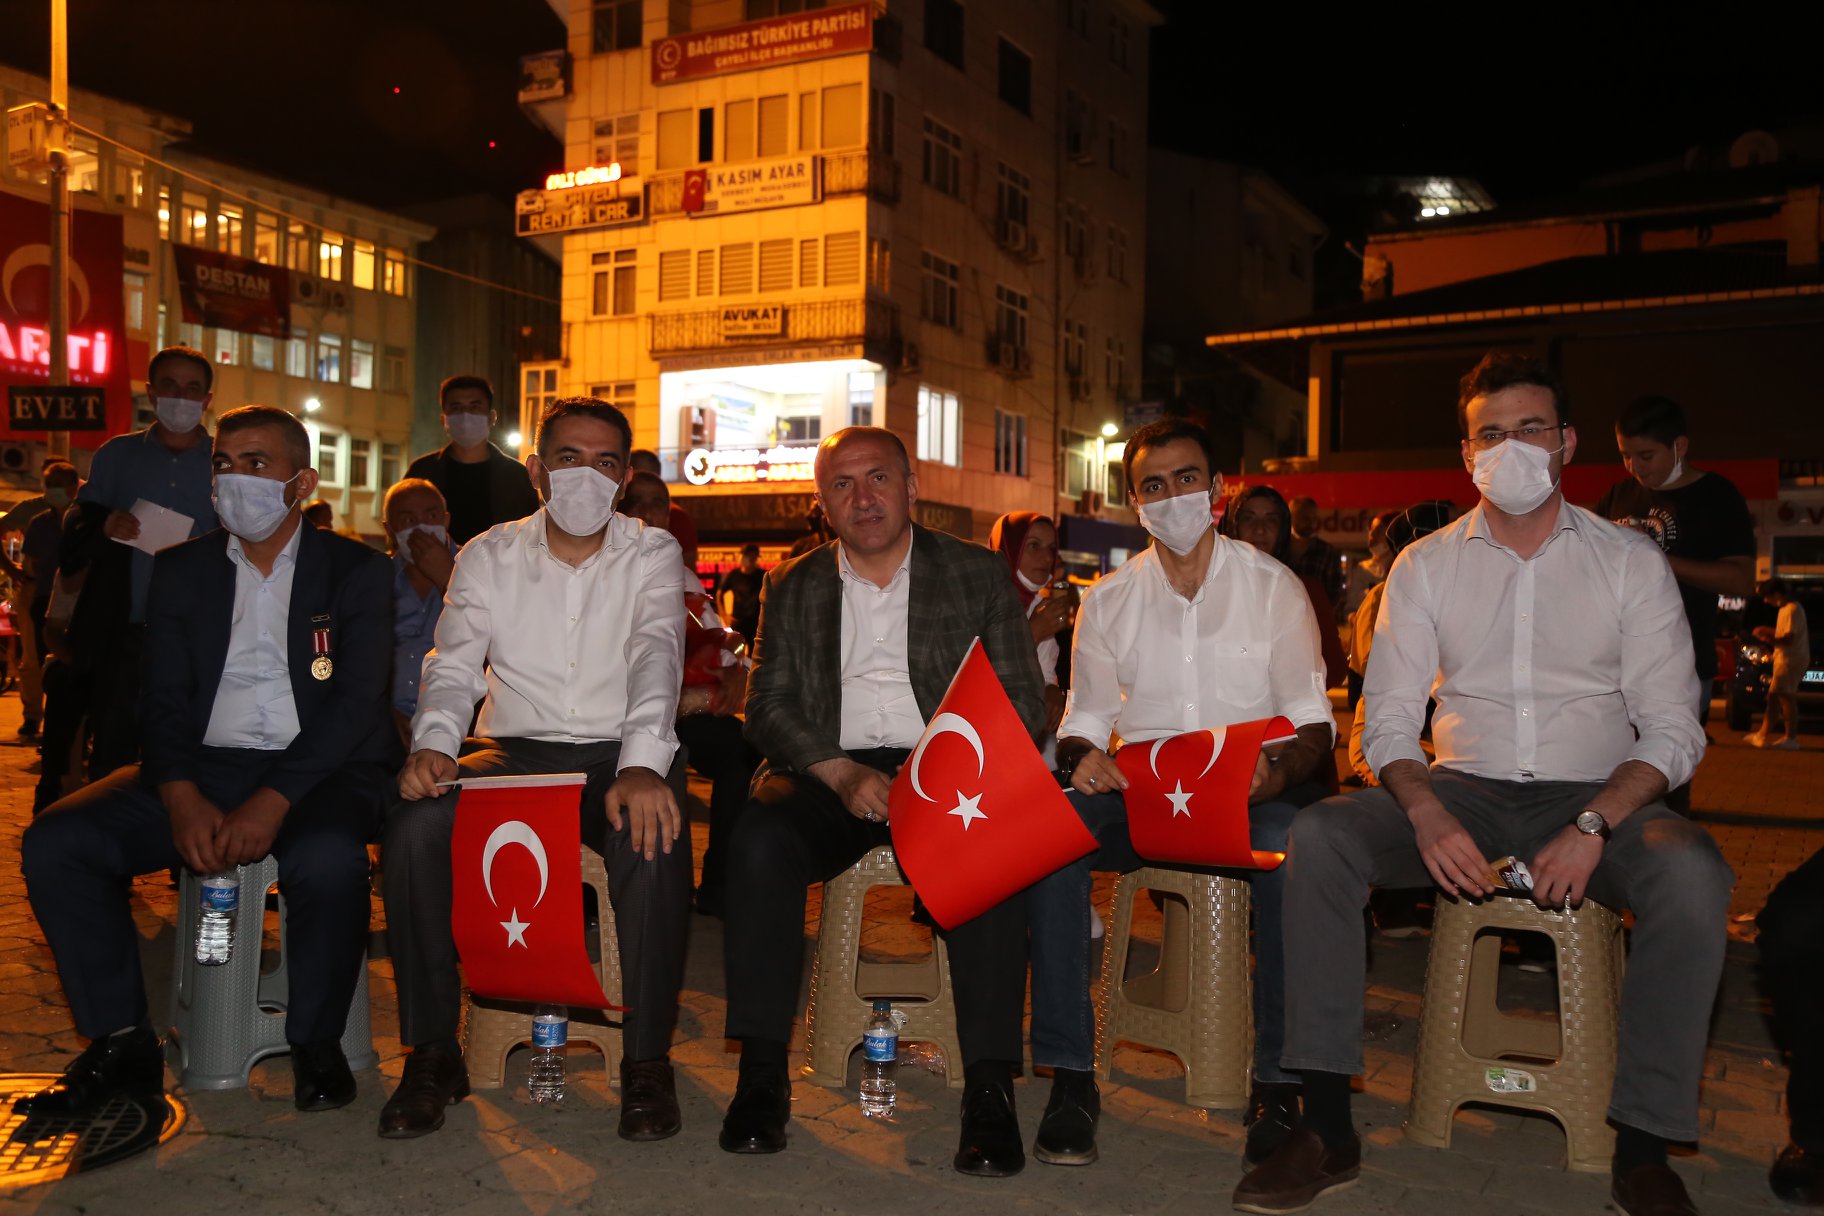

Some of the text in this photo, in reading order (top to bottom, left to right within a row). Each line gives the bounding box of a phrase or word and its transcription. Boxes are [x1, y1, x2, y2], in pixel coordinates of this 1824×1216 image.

[688, 8, 866, 57] BAĞIMSIZ TÜRKİYE PARTİSİ
[717, 162, 805, 187] KASIM AYAR
[529, 201, 628, 231] RENT A CAR
[195, 263, 271, 294] DESTAN
[723, 307, 779, 322] AVUKAT
[14, 395, 101, 420] EVET
